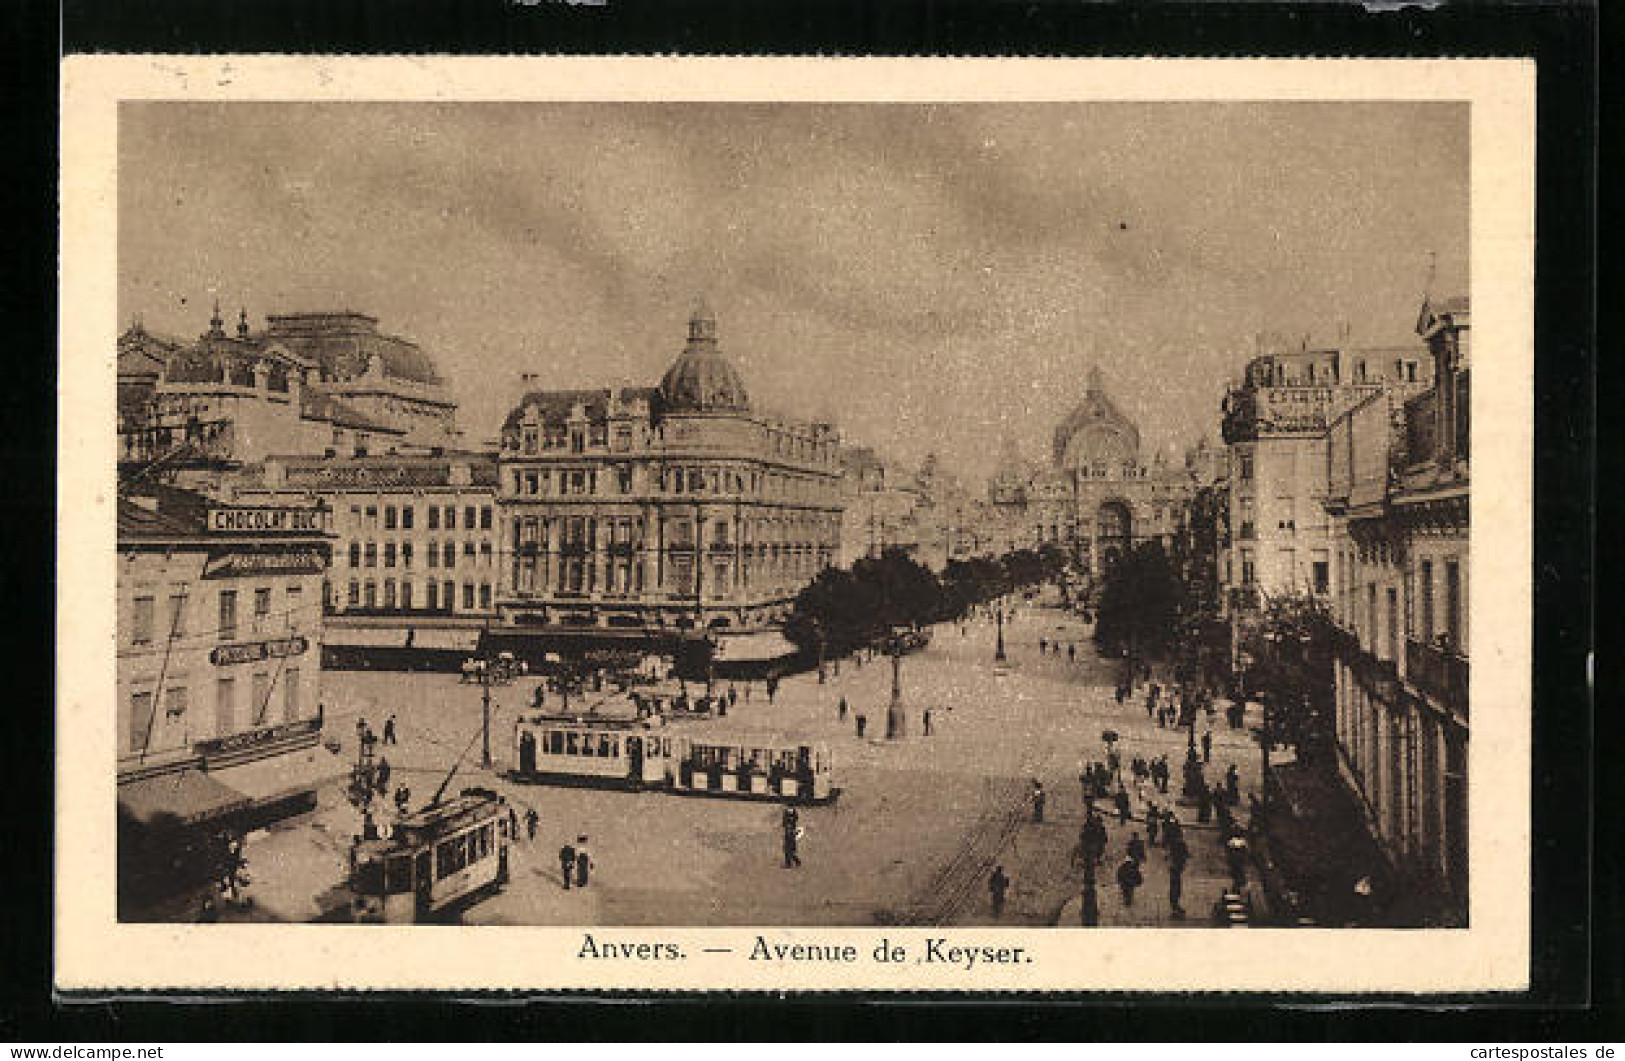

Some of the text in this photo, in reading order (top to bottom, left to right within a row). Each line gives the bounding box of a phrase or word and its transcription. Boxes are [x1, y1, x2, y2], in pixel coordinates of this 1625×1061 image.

[215, 511, 287, 529] CHOCOLAT
[578, 933, 687, 960] Anvers.
[748, 935, 857, 962] Avenue
[873, 938, 906, 963] de
